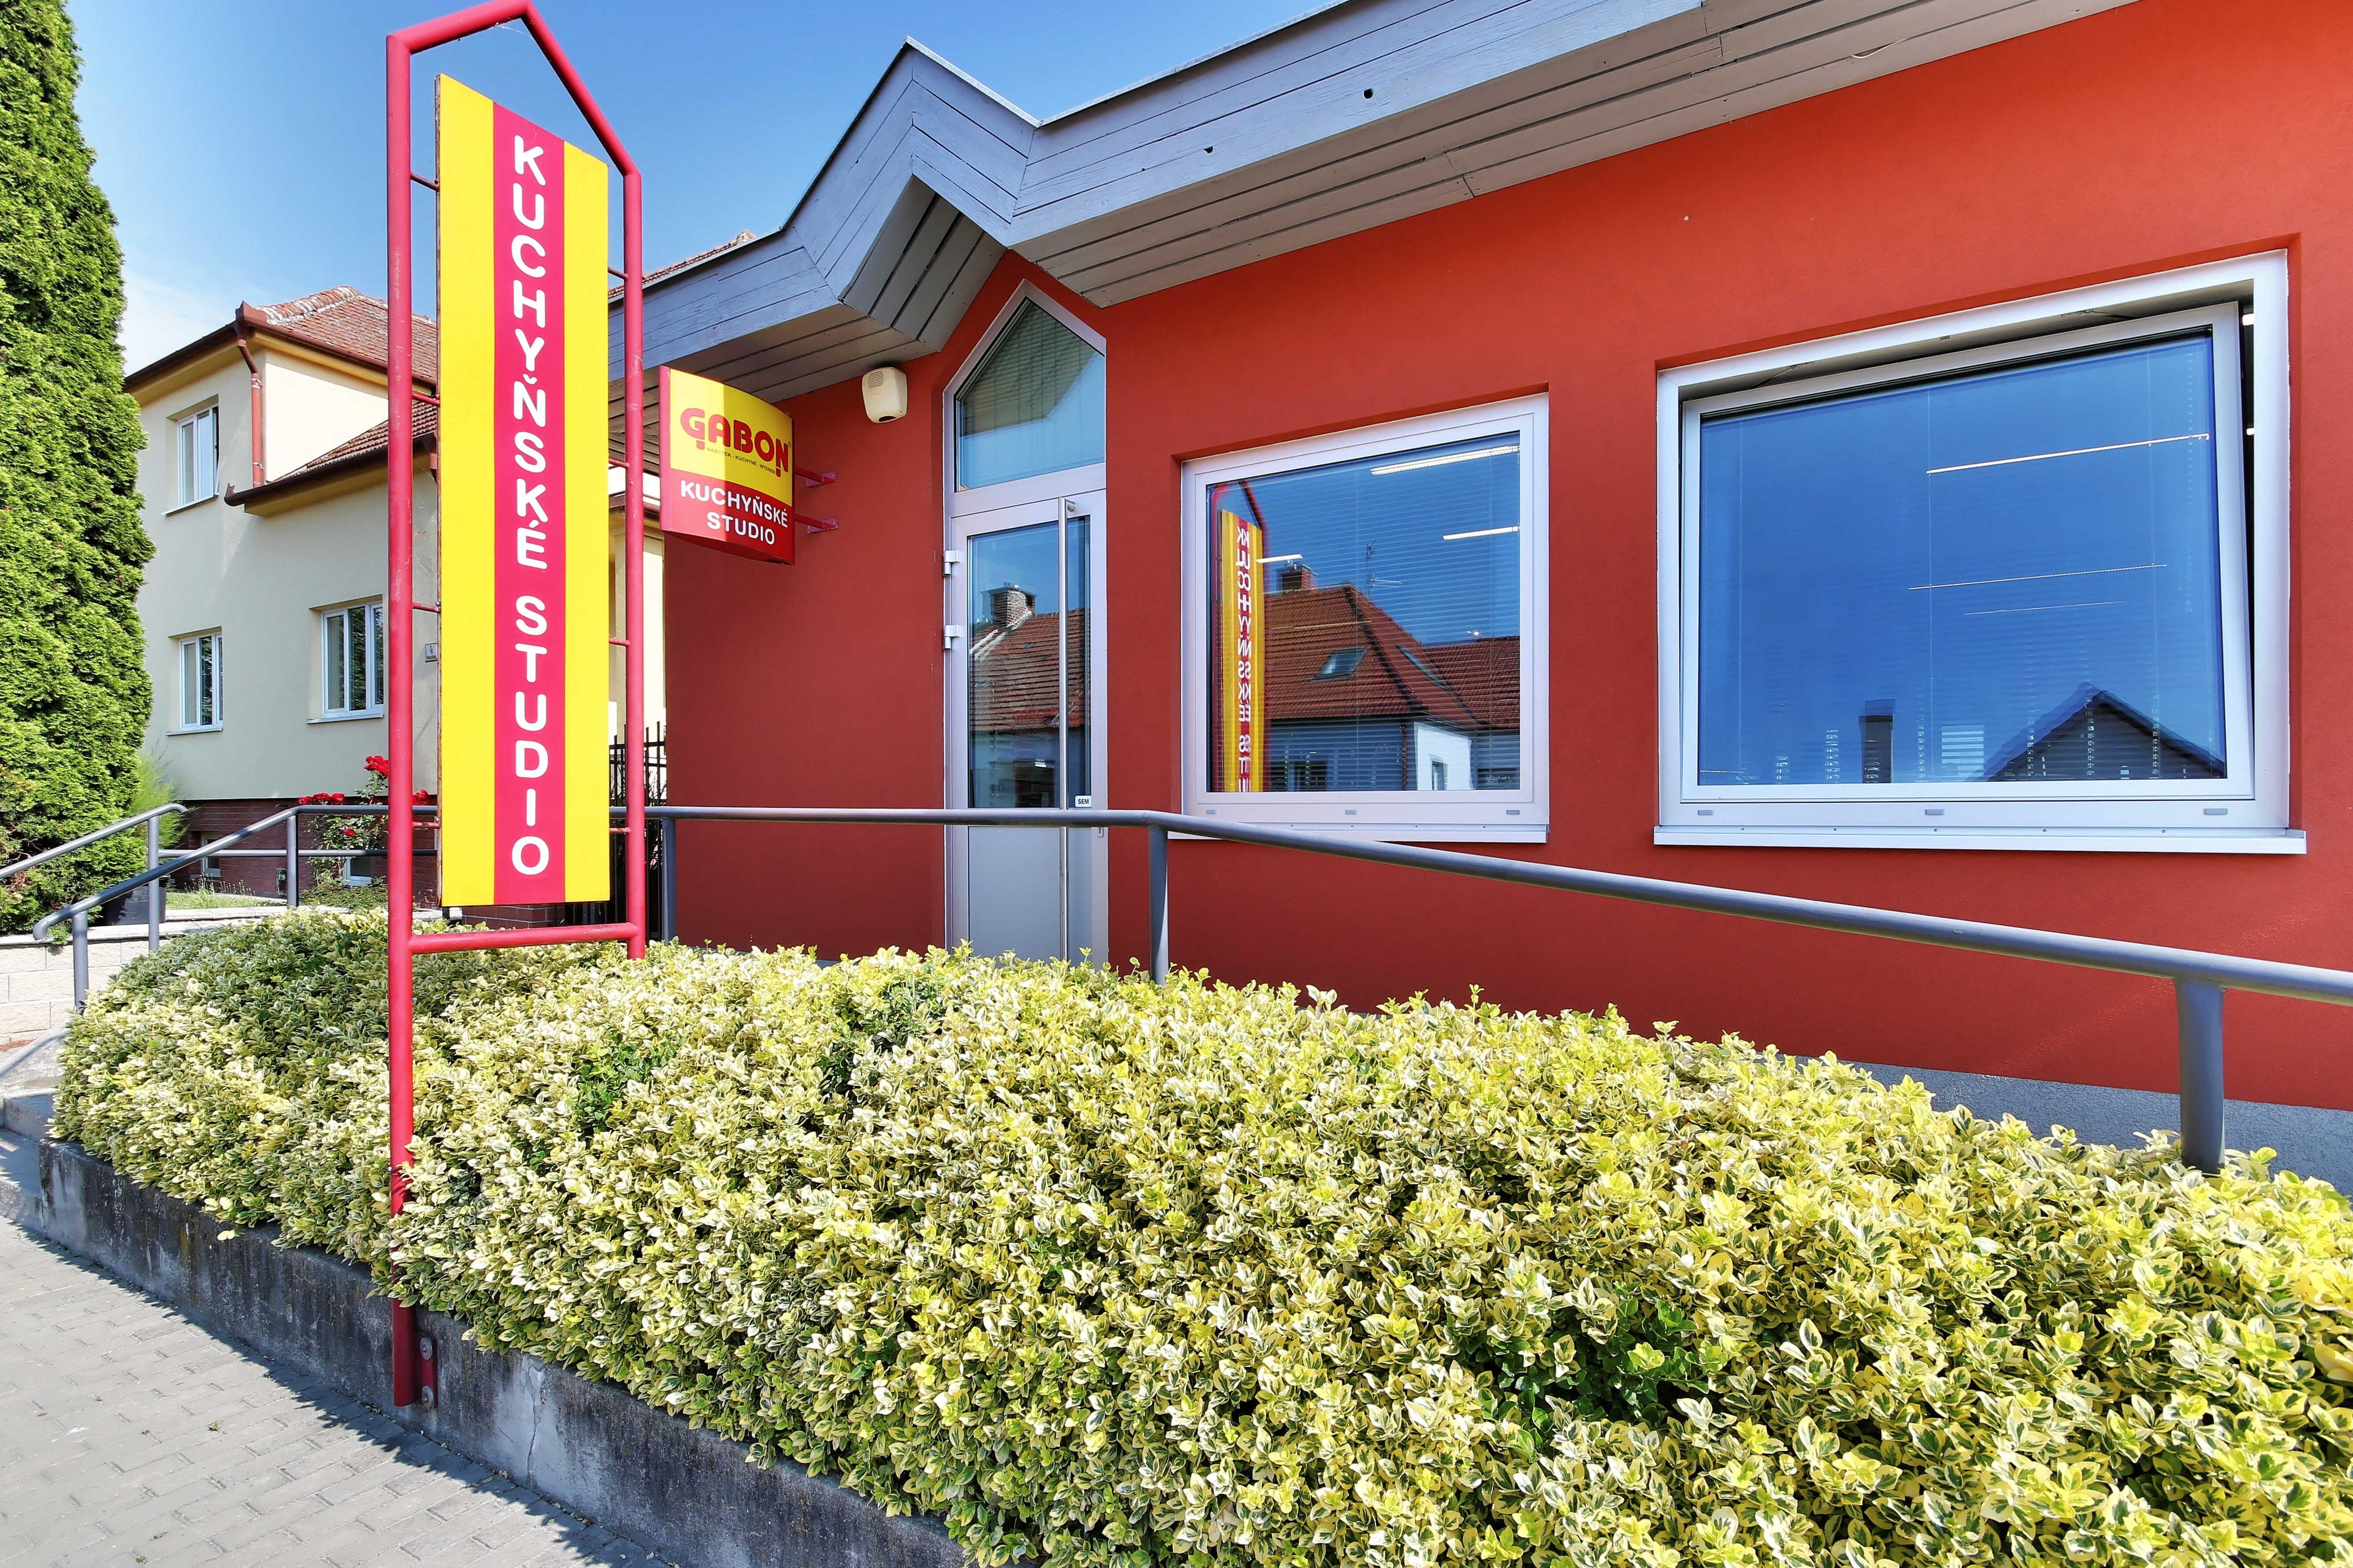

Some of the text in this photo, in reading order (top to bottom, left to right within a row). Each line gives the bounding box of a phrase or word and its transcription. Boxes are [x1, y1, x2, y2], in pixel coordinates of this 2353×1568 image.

[680, 408, 789, 478] GABON
[511, 135, 549, 875] KUCHYŇSKÉ STUDIO
[681, 480, 788, 528] KUCHYŇSKÉ
[706, 511, 775, 545] STUDIO
[429, 645, 434, 654] 4
